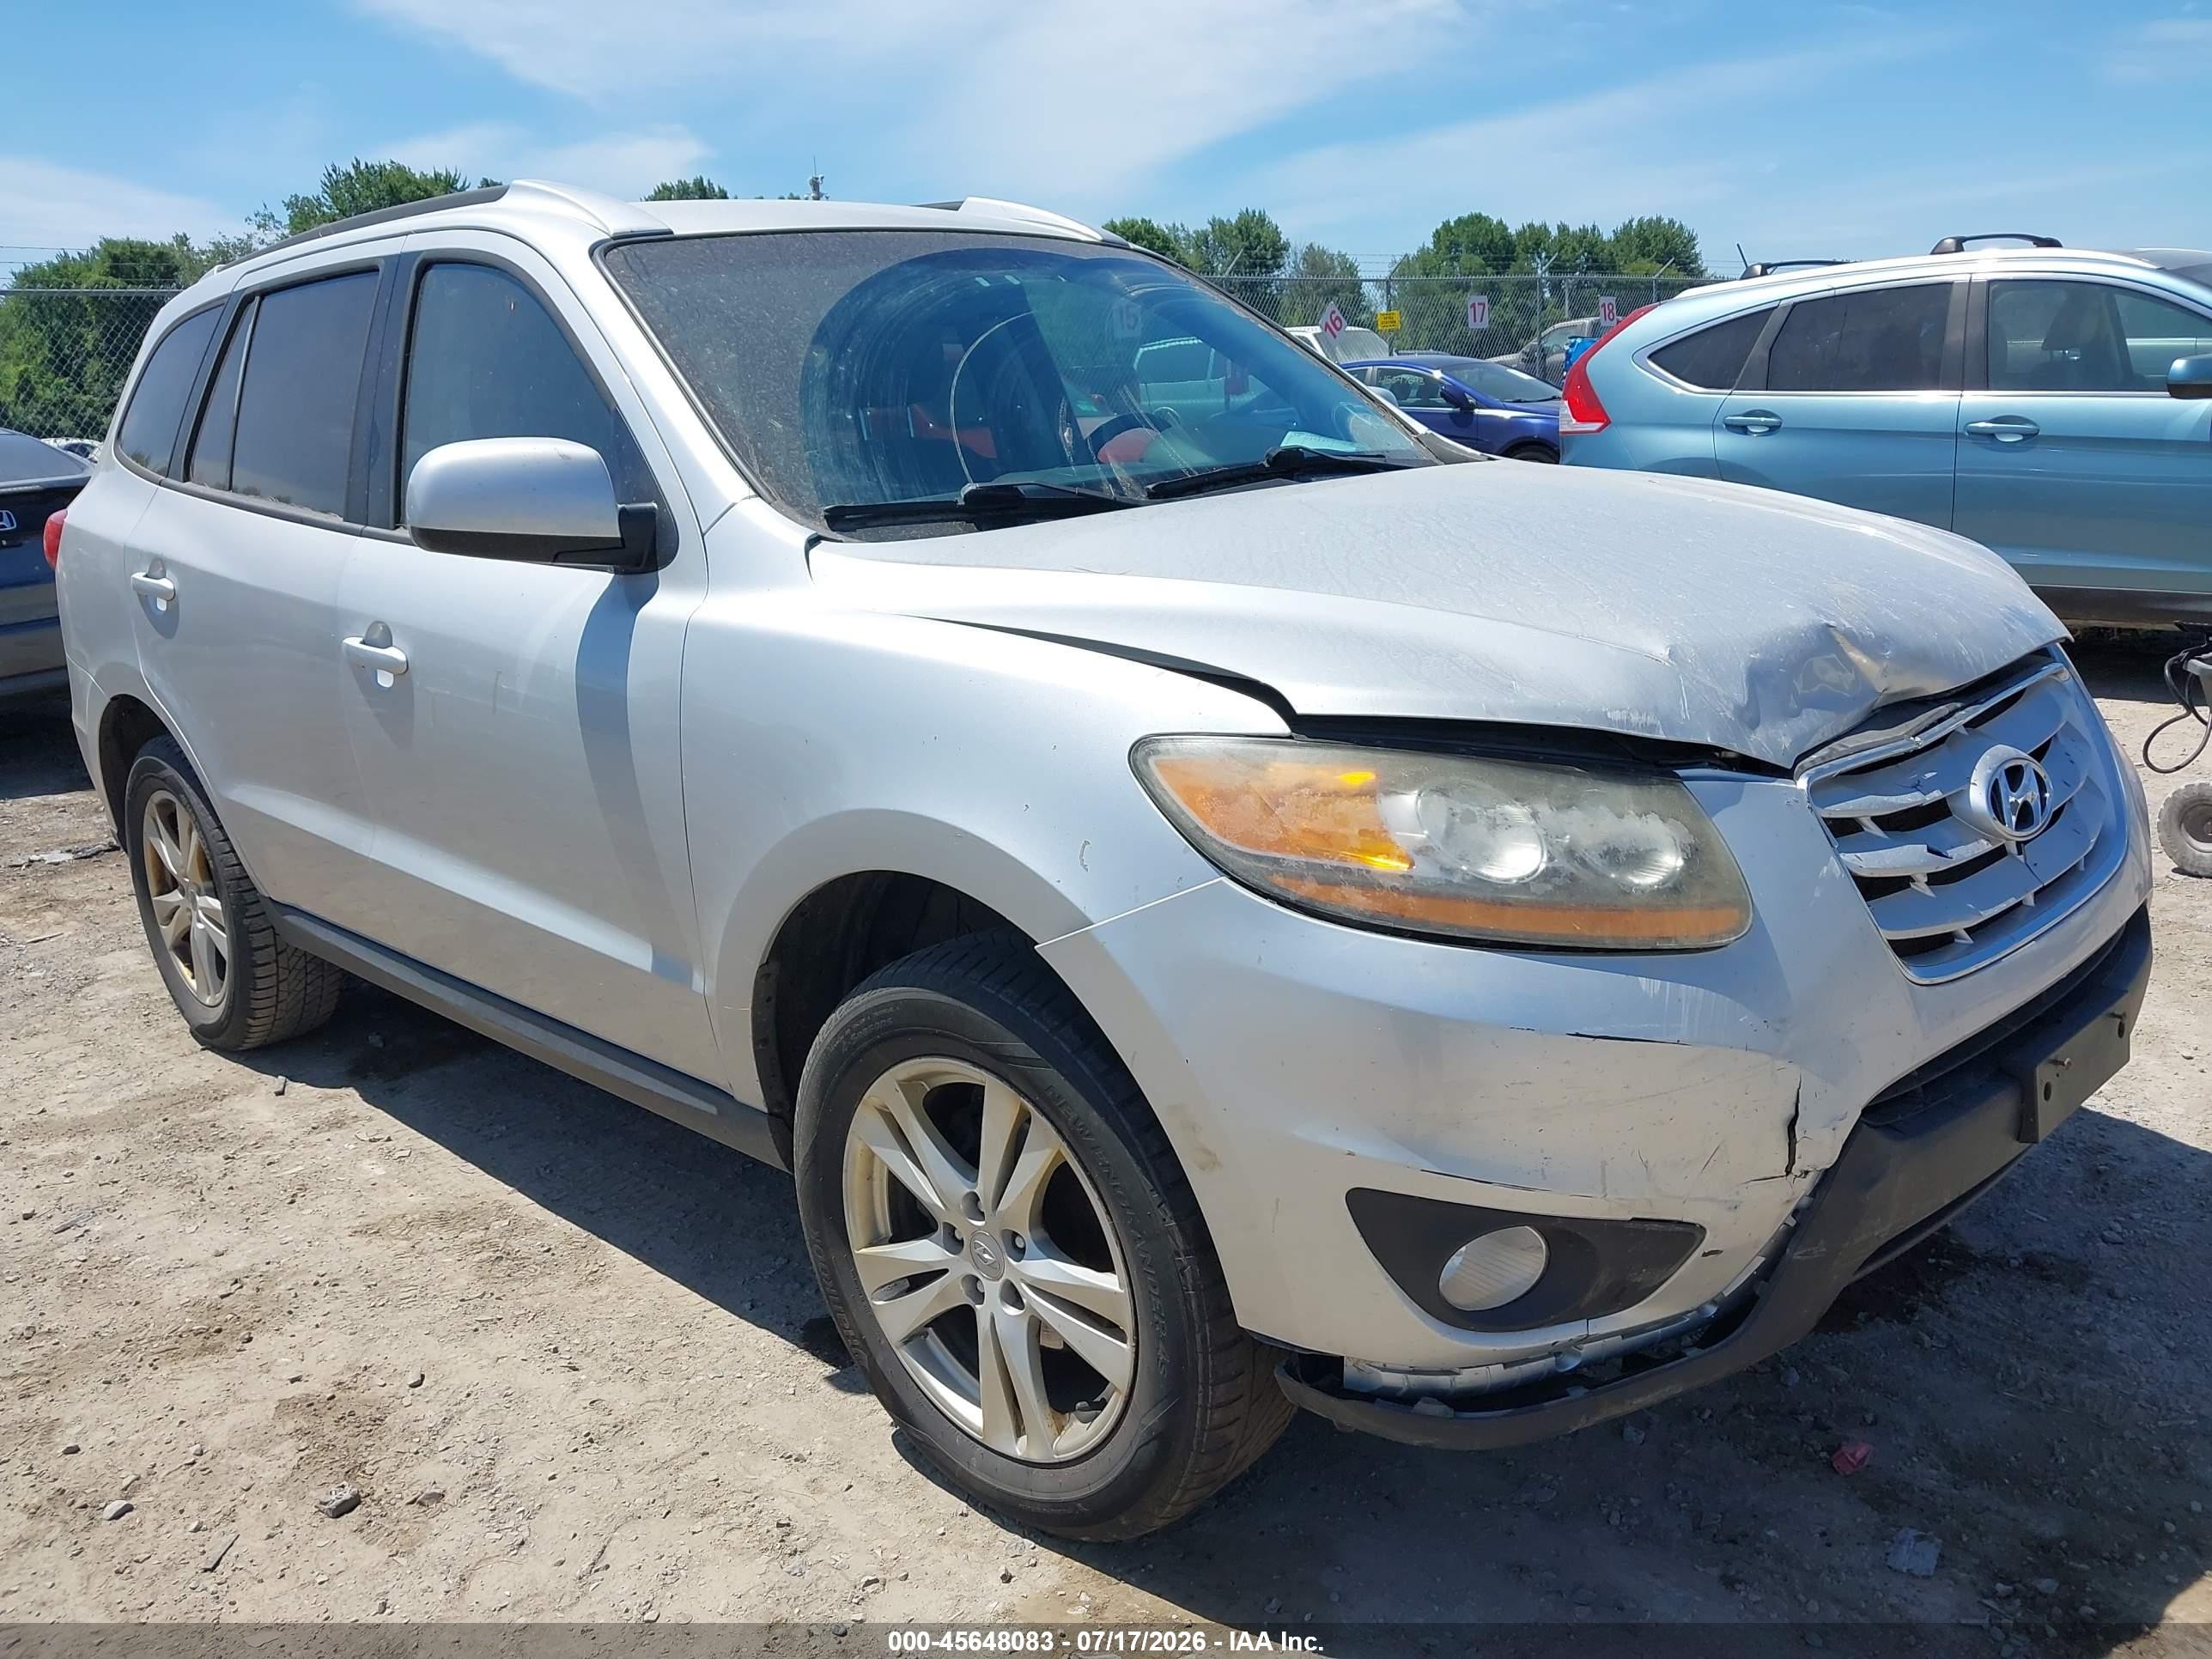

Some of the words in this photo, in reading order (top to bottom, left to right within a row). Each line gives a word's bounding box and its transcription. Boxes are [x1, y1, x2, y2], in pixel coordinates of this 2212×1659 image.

[1469, 301, 1486, 324] 17
[1600, 301, 1616, 322] 18
[1323, 309, 1343, 339] 16
